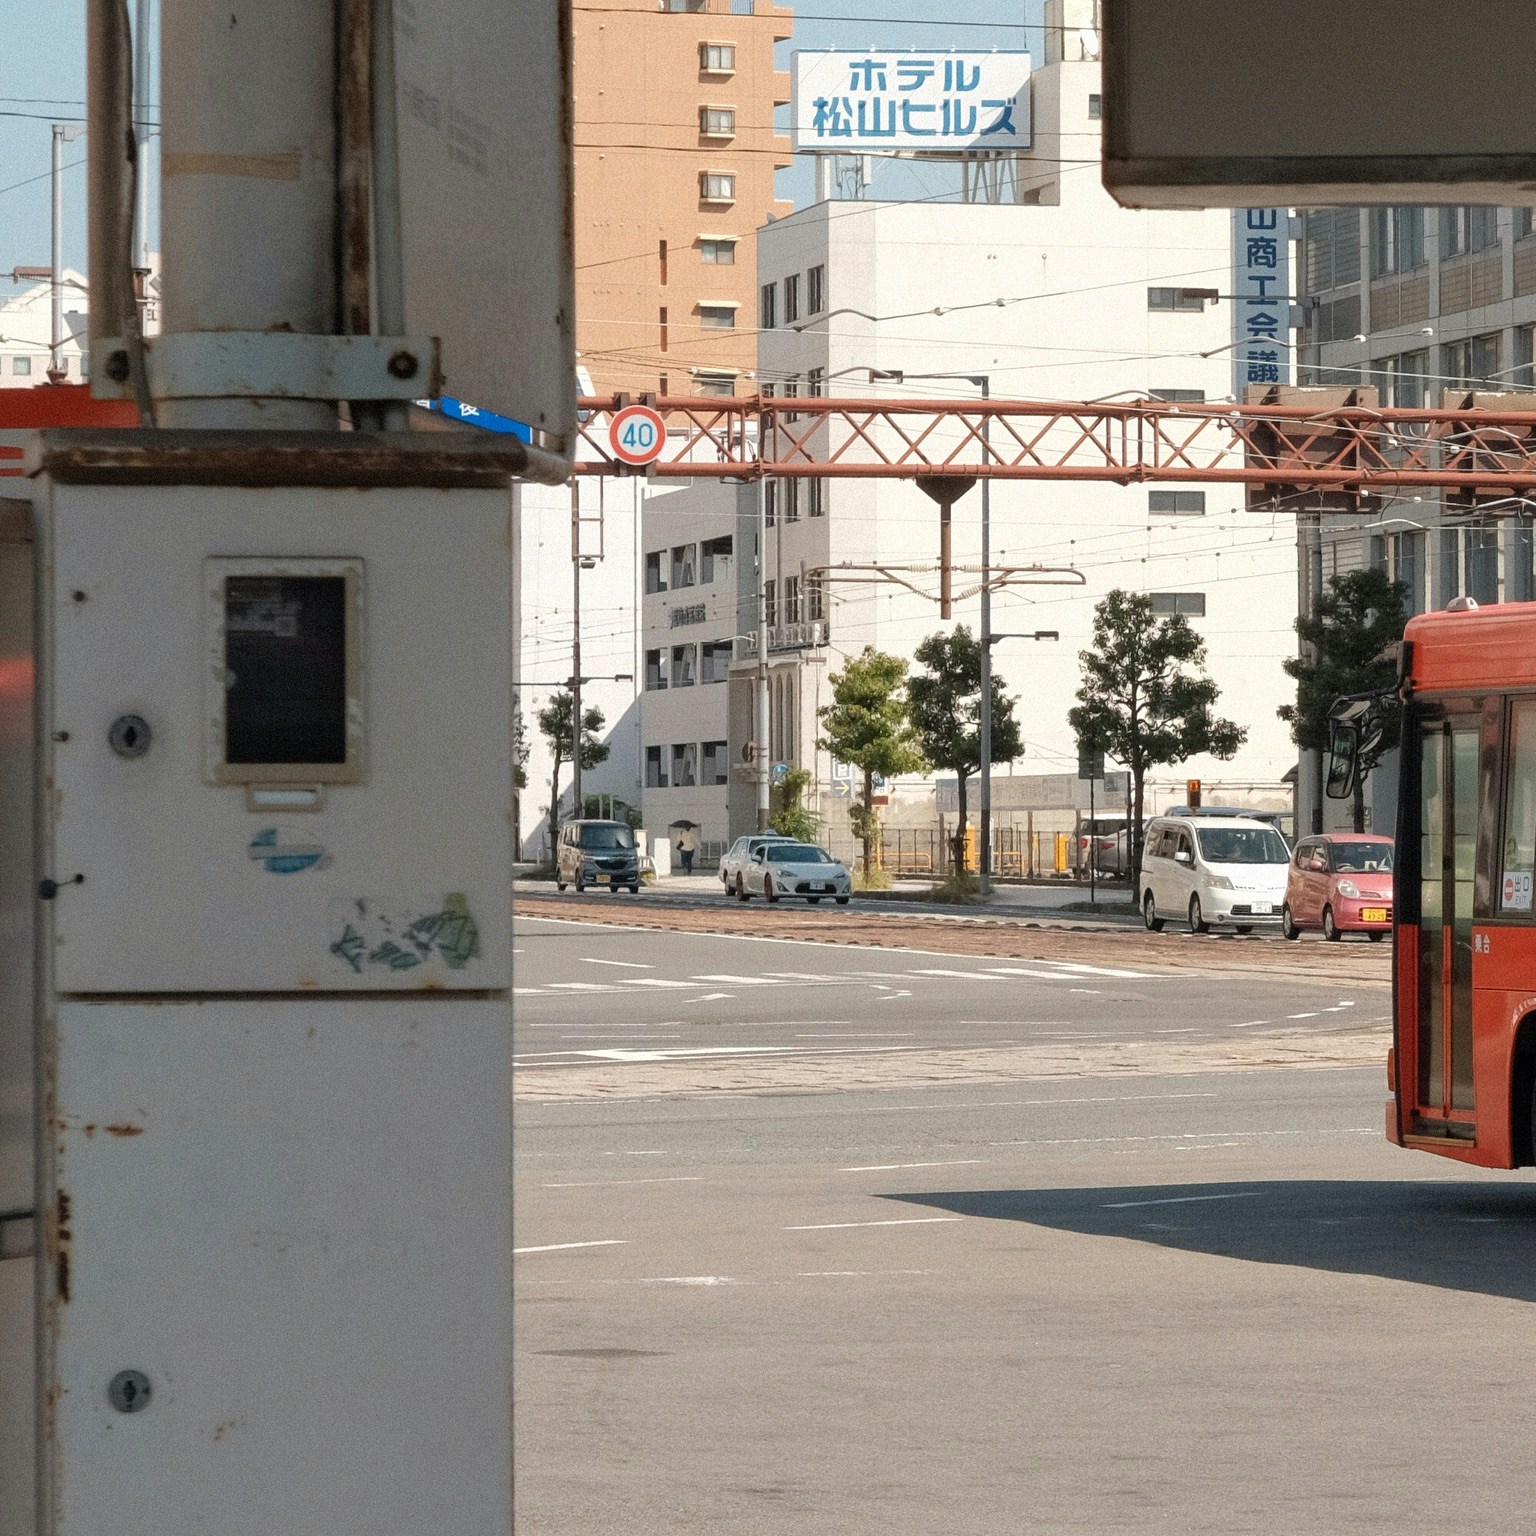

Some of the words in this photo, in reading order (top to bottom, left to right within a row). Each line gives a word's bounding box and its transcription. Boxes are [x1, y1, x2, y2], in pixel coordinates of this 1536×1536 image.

[849, 58, 981, 92] ホテル
[812, 96, 1017, 138] 松山ヒルズ
[622, 422, 653, 448] 40
